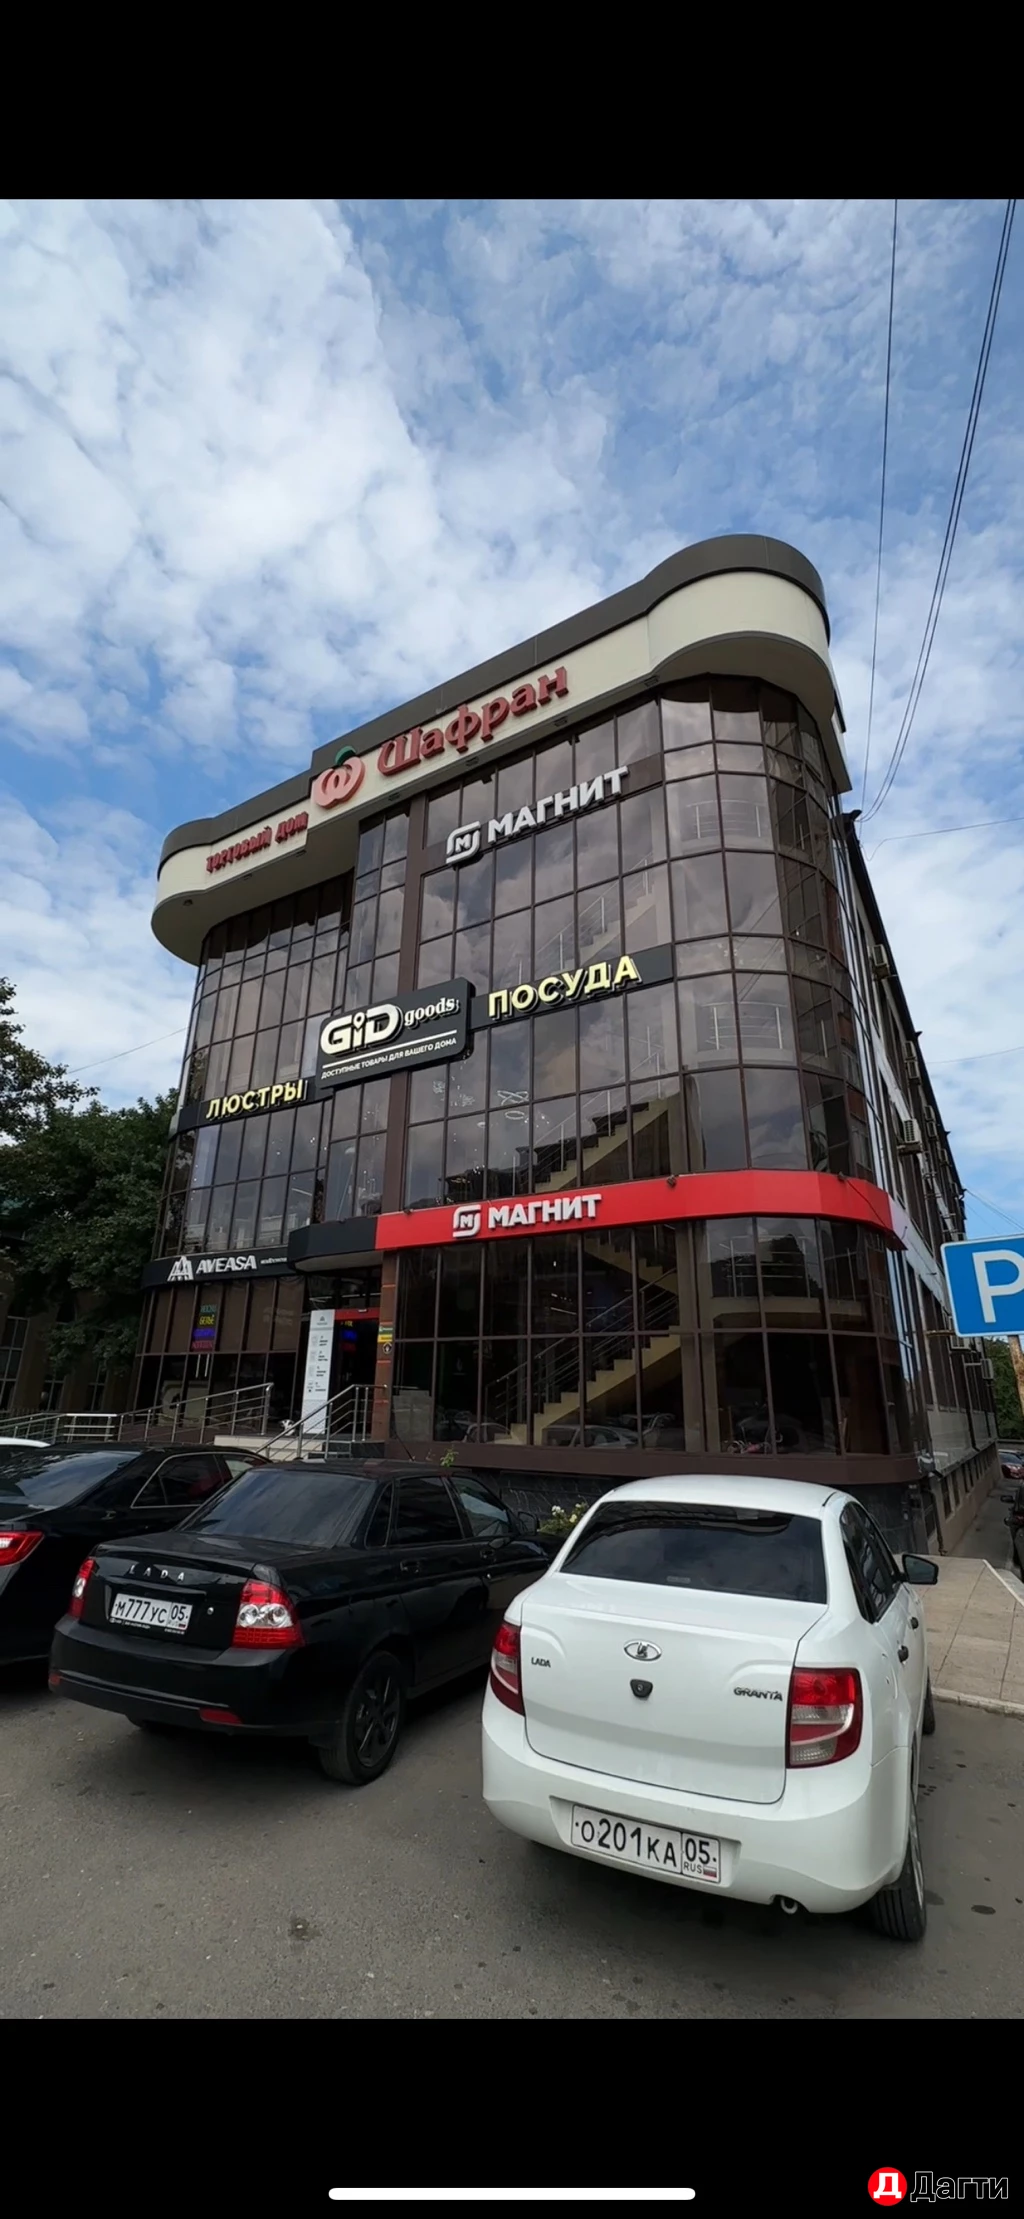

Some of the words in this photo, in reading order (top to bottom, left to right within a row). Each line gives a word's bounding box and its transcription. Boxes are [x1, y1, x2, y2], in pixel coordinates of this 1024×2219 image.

[377, 666, 569, 777] Шафран
[487, 765, 629, 844] МАГНИТ
[488, 955, 640, 1018] ПОСУДА
[404, 998, 457, 1026] goods
[321, 1062, 361, 1080] ДОСТУПНЫЕ
[361, 1055, 388, 1069] ТОВАРЫ
[388, 1051, 404, 1062] ДЛЯ
[404, 1043, 434, 1057] ВАШЕГО
[434, 1037, 457, 1051] ДОМА
[206, 1079, 304, 1119] ЛЮСТРЫ
[487, 1193, 602, 1229] МАГНИТ
[196, 1255, 257, 1274] AVEASA
[972, 1249, 1024, 1323] P
[129, 1564, 185, 1581] LADA
[171, 1605, 187, 1621] 05
[530, 1656, 551, 1668] LADA
[733, 1686, 783, 1702] GRANTA
[685, 1838, 711, 1865] 05
[683, 1861, 703, 1874] RUS
